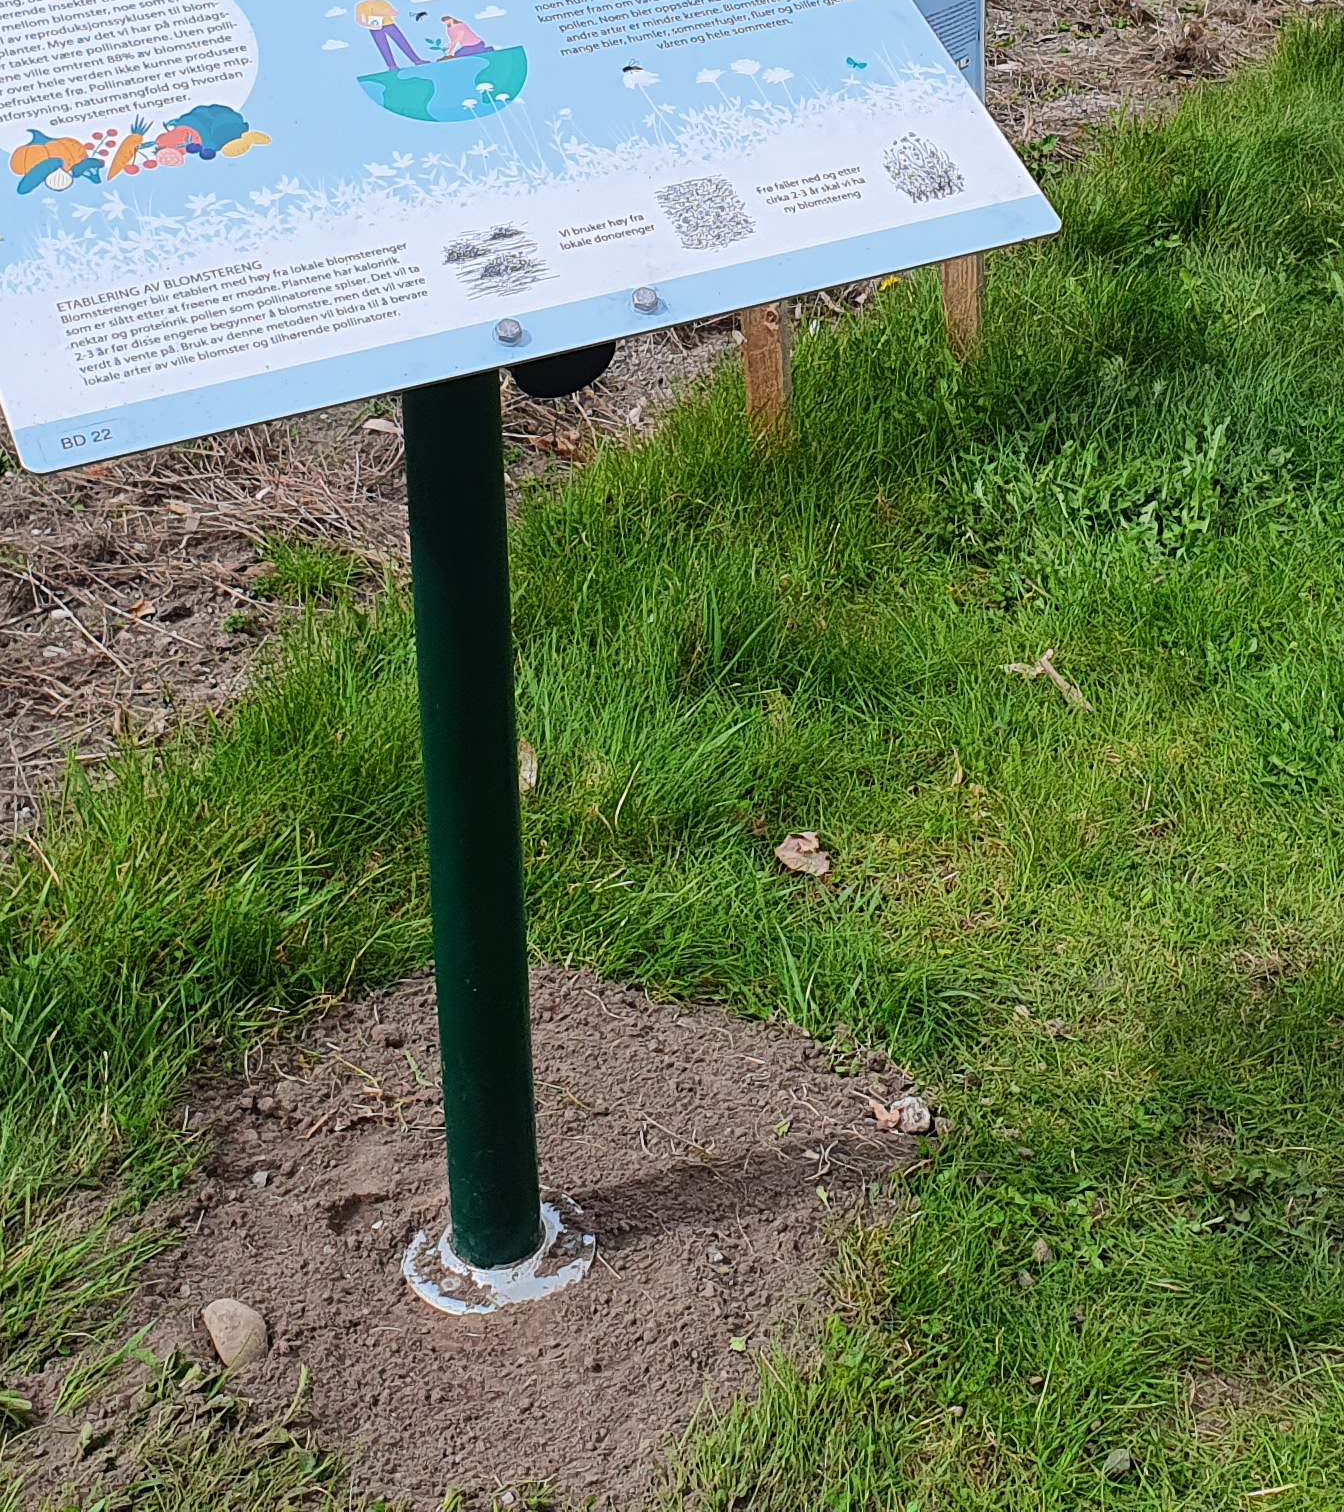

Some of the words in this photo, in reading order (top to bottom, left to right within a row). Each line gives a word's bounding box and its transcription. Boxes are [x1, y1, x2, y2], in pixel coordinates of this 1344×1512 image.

[1, 18, 50, 32] mellom
[112, 3, 136, 13] noe
[7, 35, 21, 44] av
[24, 10, 166, 41] reproduksjonssyklusen
[167, 5, 181, 15] til
[46, 39, 74, 49] Mye
[77, 35, 91, 44] av
[93, 30, 116, 40] det
[116, 27, 129, 36] vi
[130, 24, 151, 34] har
[154, 19, 170, 32] på
[8, 55, 49, 68] takket
[50, 49, 83, 61] være
[173, 28, 204, 38] Uten
[22, 68, 50, 78] ville
[52, 57, 105, 73] omtrent
[136, 49, 151, 58] av
[153, 34, 232, 55] blomstrende
[6, 83, 34, 94] over
[36, 77, 65, 89] hele
[67, 69, 113, 83] verden
[141, 57, 182, 70] kunne
[184, 45, 247, 64] produsere
[88, 73, 161, 92] Pollinatorer
[163, 70, 176, 78] er
[178, 62, 220, 75] viktige
[74, 82, 170, 108] naturmangfold
[172, 81, 189, 90] og
[190, 71, 243, 86] hvordan
[765, 194, 790, 205] cirka
[790, 189, 808, 199] 2-3
[808, 186, 819, 195] år
[820, 181, 841, 192] skal
[841, 179, 851, 187] vi
[850, 177, 866, 185] ha
[774, 180, 799, 190] faller
[801, 173, 821, 185] ned
[822, 172, 837, 180] og
[837, 166, 860, 176] etter
[783, 205, 796, 213] ny
[796, 190, 861, 210] blomstereng
[558, 228, 571, 238] Vi
[571, 222, 606, 235] bruker
[607, 217, 628, 227] høy
[629, 214, 644, 222] fra
[559, 237, 592, 251] lokale
[594, 224, 654, 243] donorenger
[56, 286, 140, 312] ETABLERING
[143, 281, 159, 294] AV
[163, 260, 262, 289] BLOMSTERENG
[60, 299, 147, 324] Blomsterenger
[149, 294, 169, 304] blir
[172, 283, 219, 300] etablert
[220, 276, 247, 289] med
[248, 272, 270, 283] høy
[272, 268, 289, 278] fra
[289, 260, 324, 274] lokale
[325, 242, 407, 266] blomsterenger
[65, 325, 92, 336] som
[94, 321, 105, 330] er
[136, 308, 164, 320] etter
[167, 304, 180, 314] at
[180, 297, 219, 311] frøene
[221, 293, 233, 302] er
[281, 272, 332, 289] Plantene
[332, 267, 351, 277] har
[82, 371, 120, 386] lokale
[123, 365, 151, 377] arter
[154, 361, 168, 370] av
[170, 355, 195, 366] ville
[196, 343, 249, 360] blomster
[252, 339, 269, 348] og
[269, 324, 330, 344] tilhørende
[60, 434, 86, 450] BD
[90, 428, 113, 443] 22
